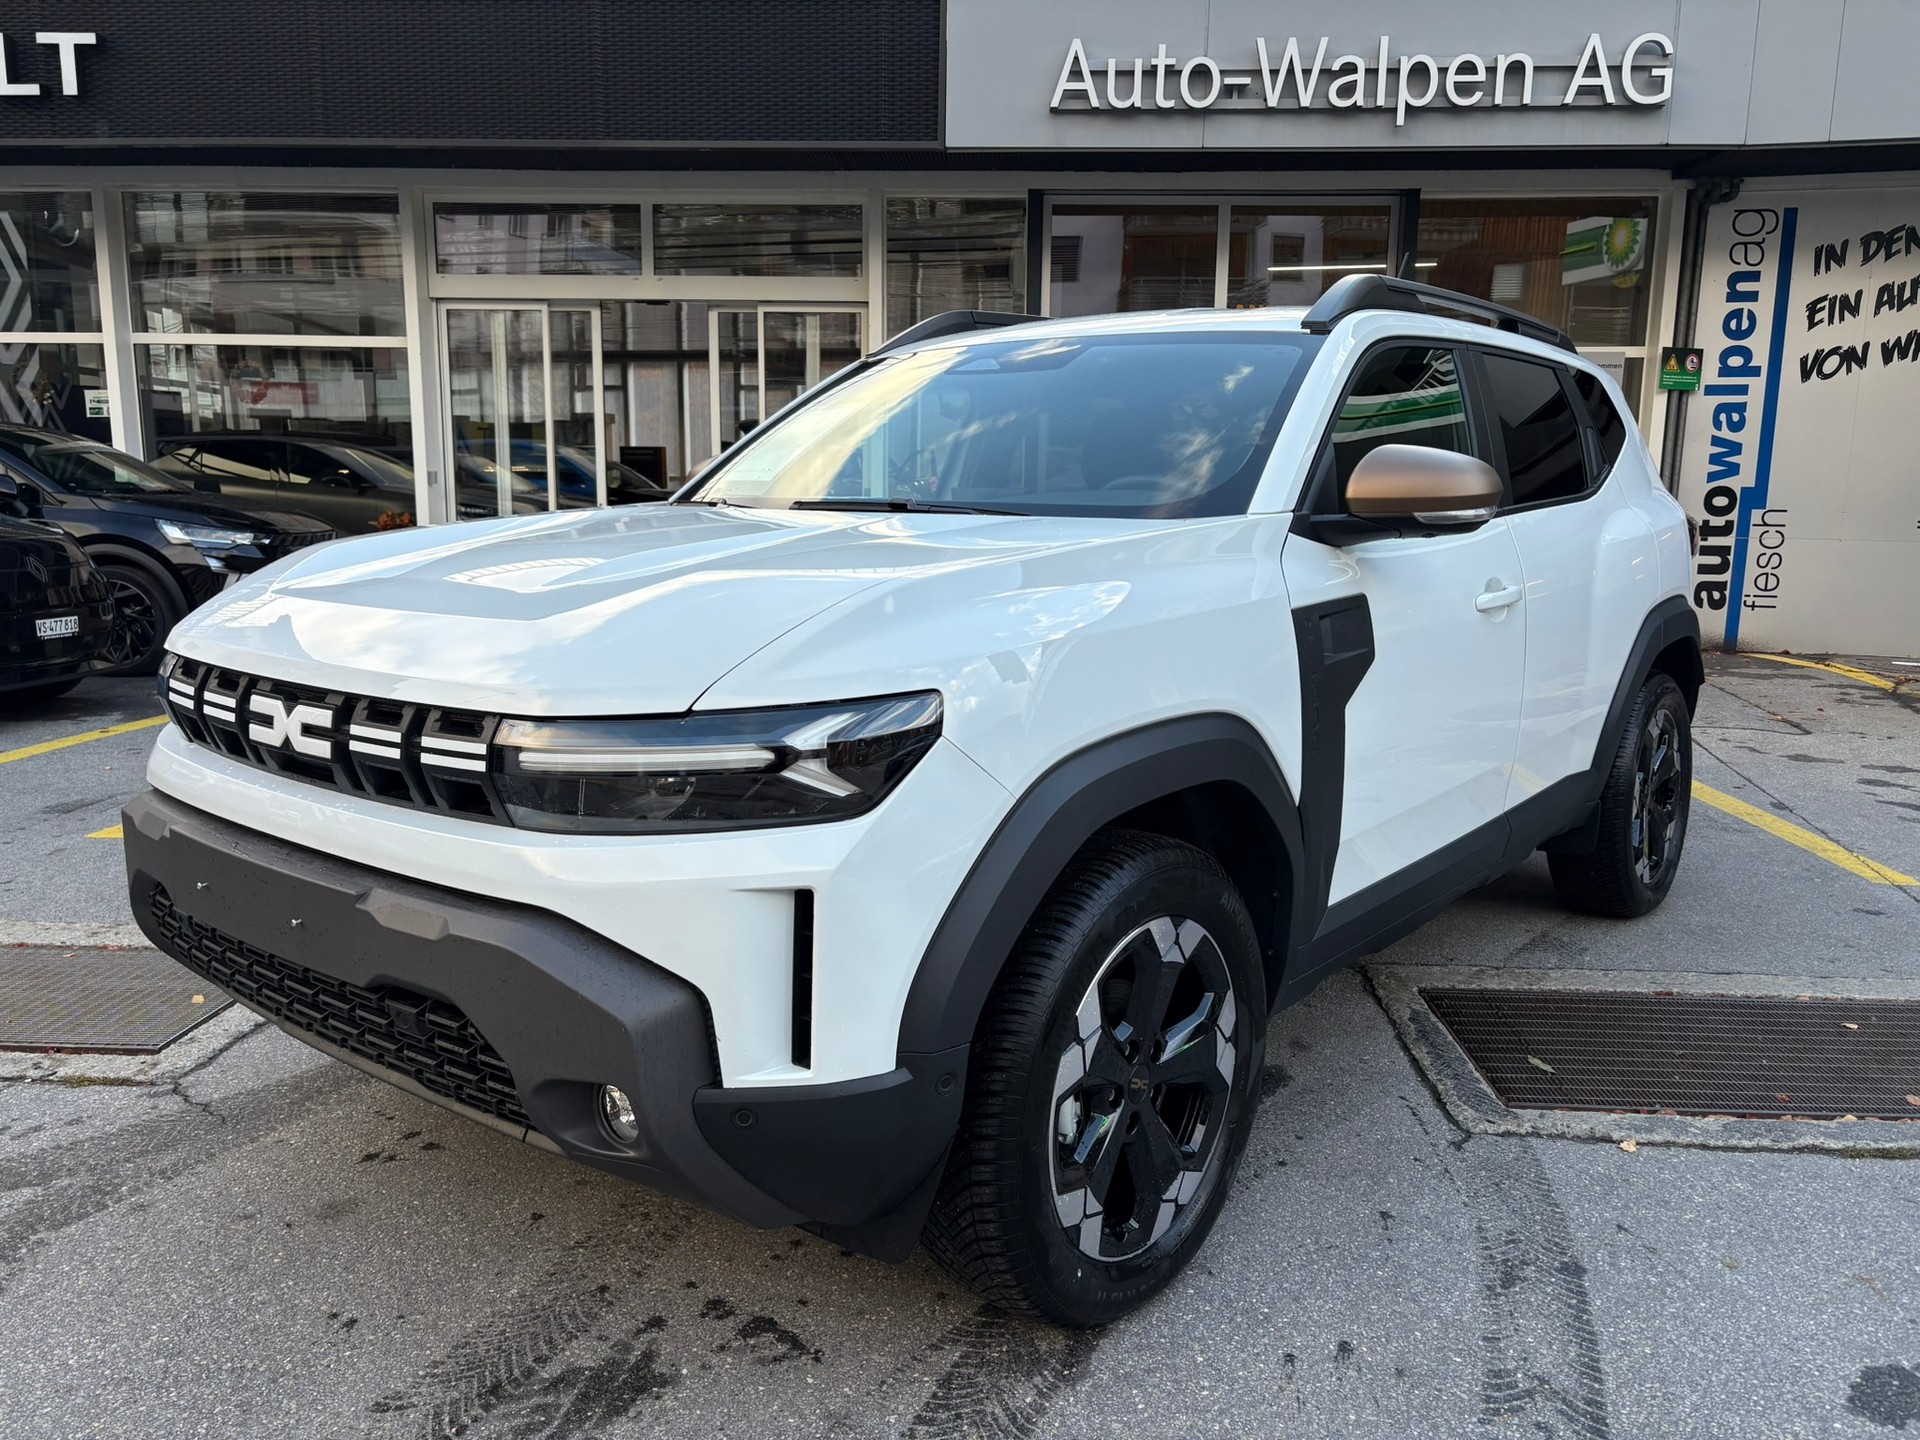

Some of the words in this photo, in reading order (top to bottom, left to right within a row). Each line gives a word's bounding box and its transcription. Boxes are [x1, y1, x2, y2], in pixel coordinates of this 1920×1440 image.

[1050, 36, 1534, 126] Auto-Walpen
[1563, 32, 1674, 105] AG
[1813, 237, 1849, 277] IN
[1806, 288, 1863, 332] EIN
[1800, 340, 1870, 384] VON
[1743, 508, 1788, 611] fiesch
